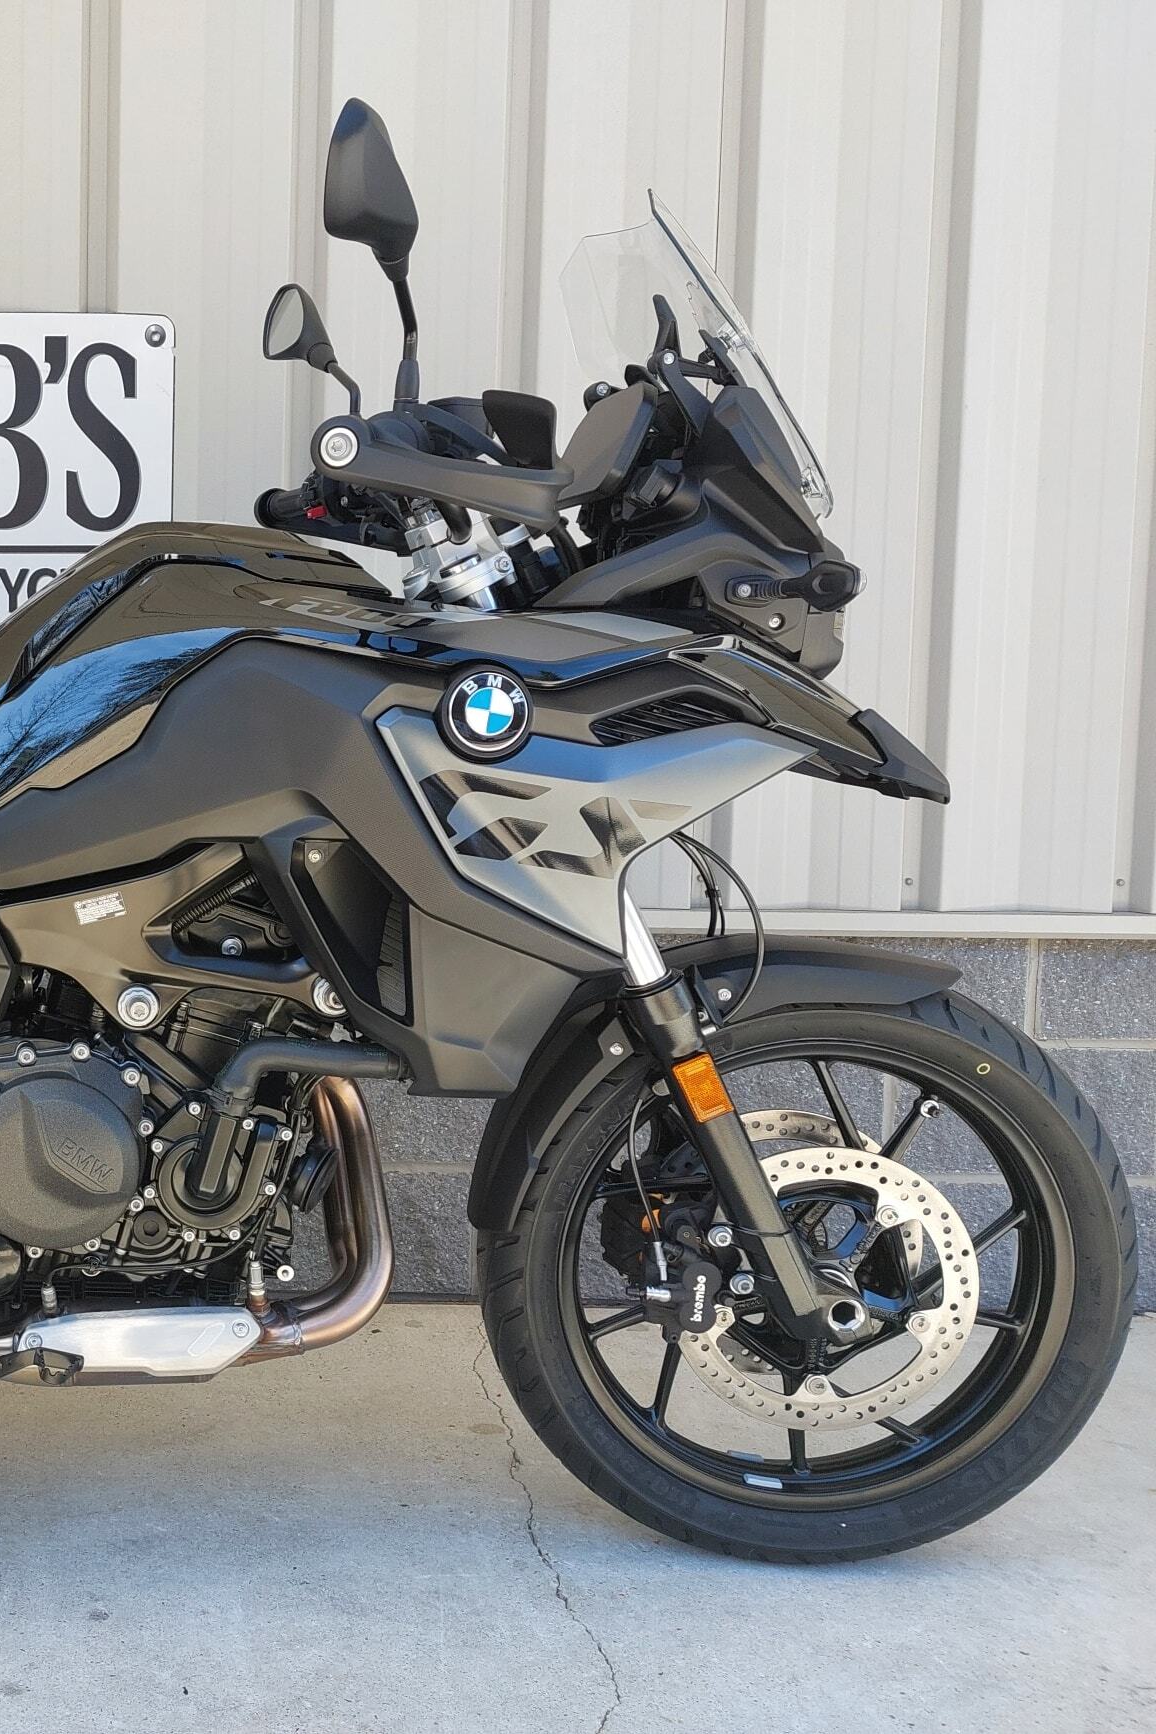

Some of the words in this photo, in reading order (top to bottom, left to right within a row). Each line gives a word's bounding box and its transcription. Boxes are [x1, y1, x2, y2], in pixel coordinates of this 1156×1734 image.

[462, 675, 525, 704] BMW
[56, 1137, 115, 1183] BMW
[690, 1275, 707, 1322] brembo
